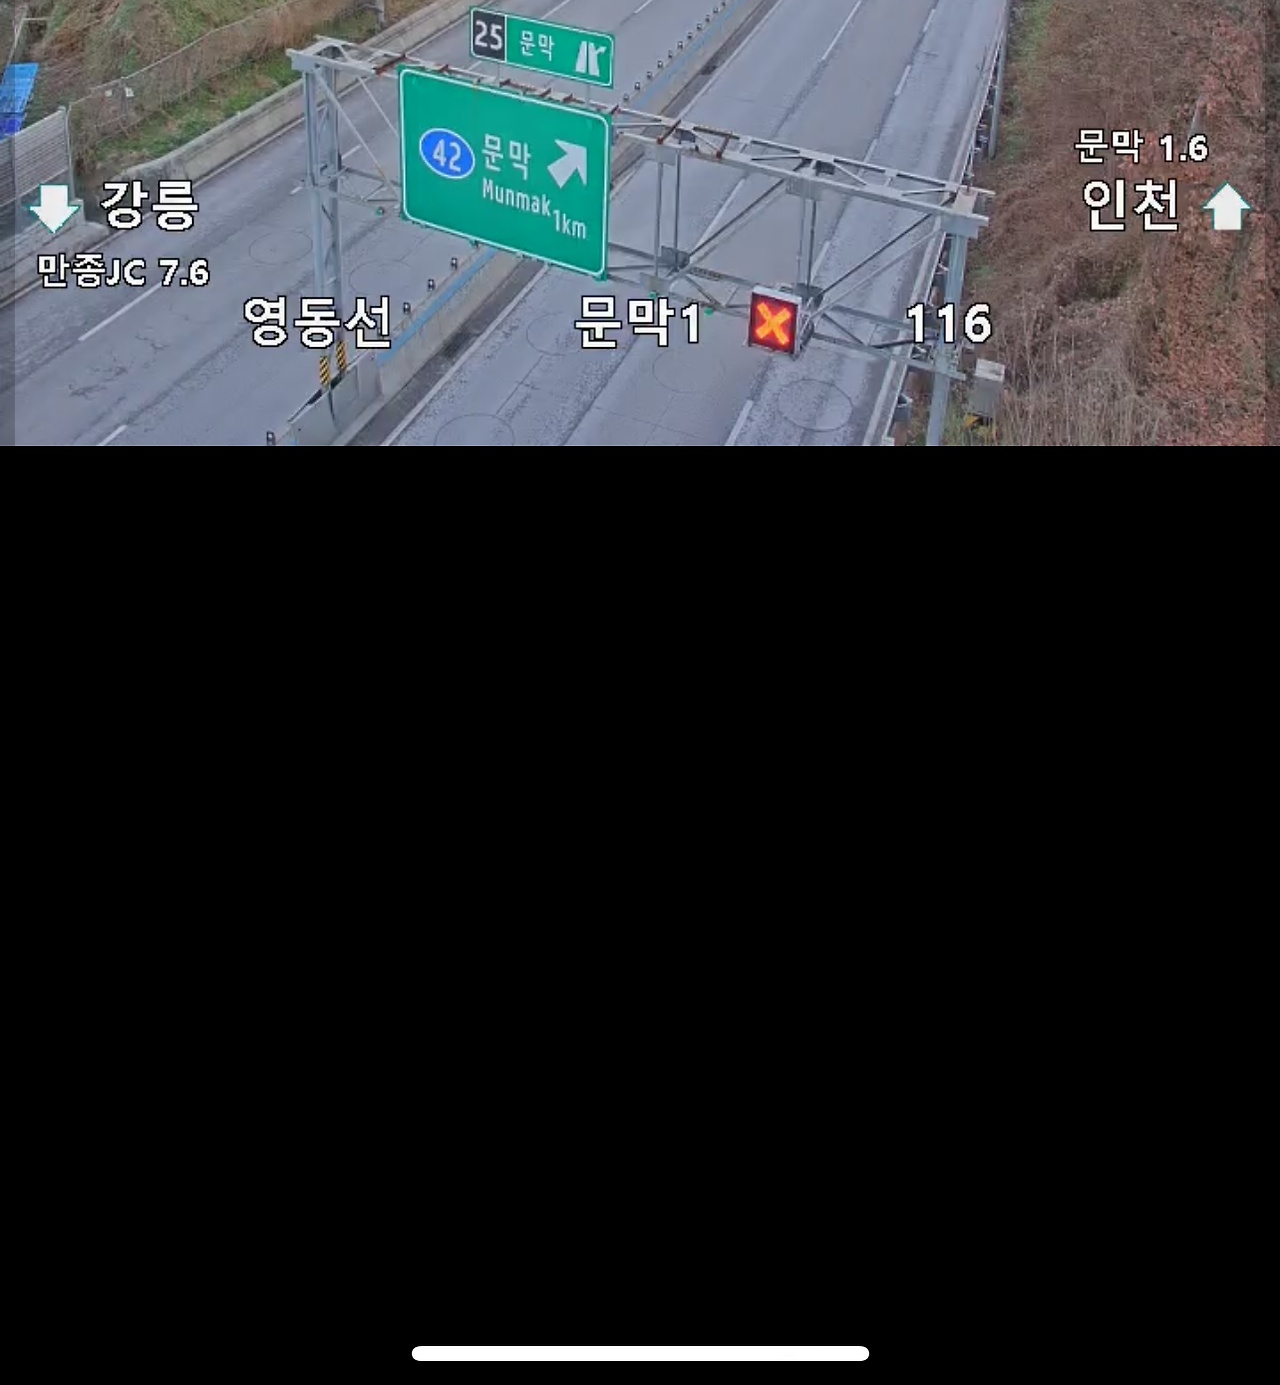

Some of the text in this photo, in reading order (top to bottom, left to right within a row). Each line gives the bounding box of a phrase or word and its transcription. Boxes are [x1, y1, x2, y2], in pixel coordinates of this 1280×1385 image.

[474, 20, 503, 51] 25
[520, 30, 555, 62] 문막
[432, 138, 462, 173] 42
[481, 133, 532, 181] 문막
[482, 177, 551, 217] Munmak
[553, 209, 587, 240] 1km
